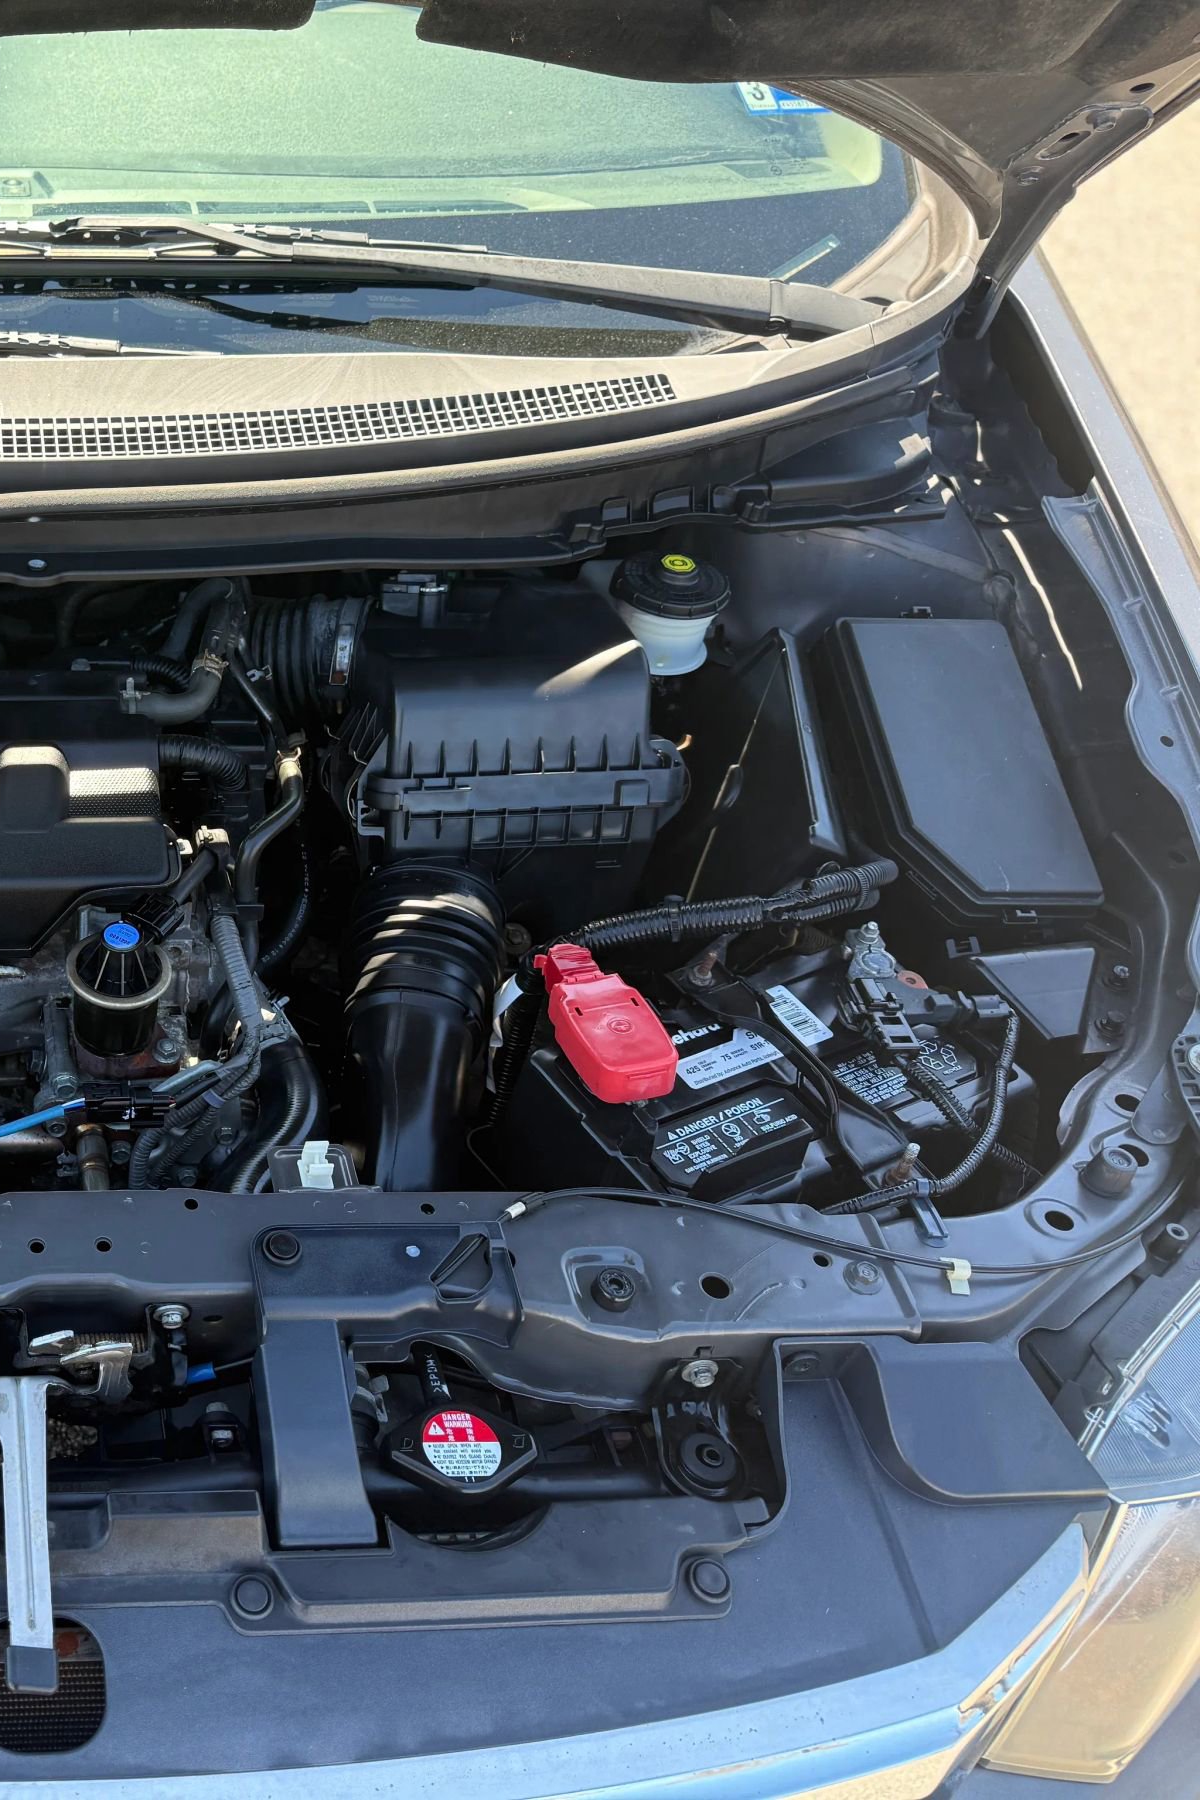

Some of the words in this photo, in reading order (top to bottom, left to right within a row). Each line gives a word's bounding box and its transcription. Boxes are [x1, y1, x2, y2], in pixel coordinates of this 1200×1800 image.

[721, 1054, 732, 1062] 75
[686, 1065, 701, 1075] 425
[675, 1115, 720, 1137] DANGER
[726, 1097, 764, 1118] POISON
[441, 1413, 471, 1421] DANGER
